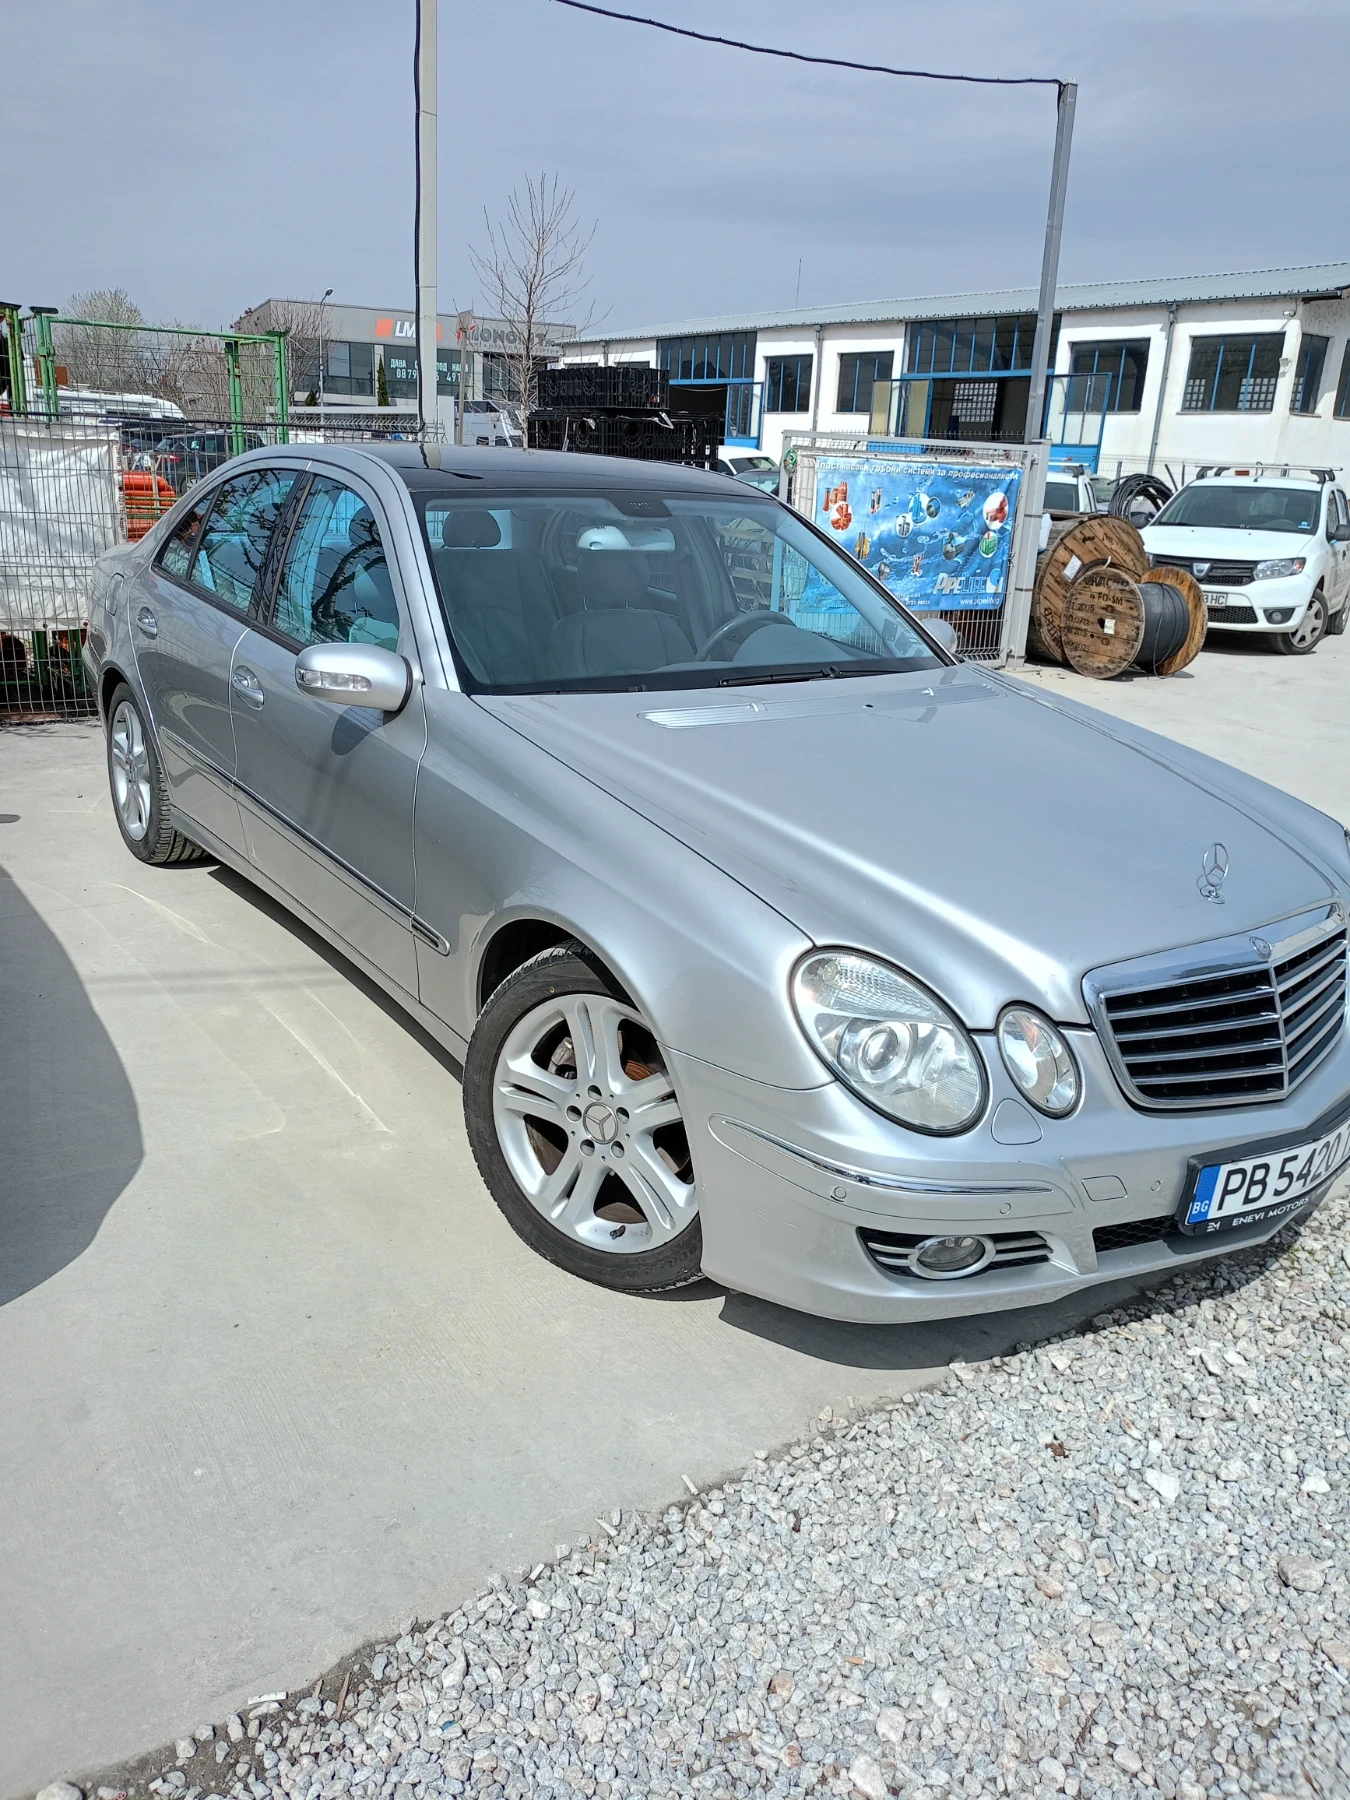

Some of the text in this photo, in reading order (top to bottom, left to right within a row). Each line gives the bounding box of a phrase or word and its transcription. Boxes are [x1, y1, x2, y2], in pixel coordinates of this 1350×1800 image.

[390, 358, 407, 369] ДАВА
[936, 469, 946, 477] за
[1217, 1162, 1270, 1212] PB
[1272, 1131, 1342, 1197] 5420
[1192, 1200, 1210, 1215] BG
[1232, 1211, 1265, 1227] ENEVI
[1267, 1196, 1310, 1218] MOTORS
